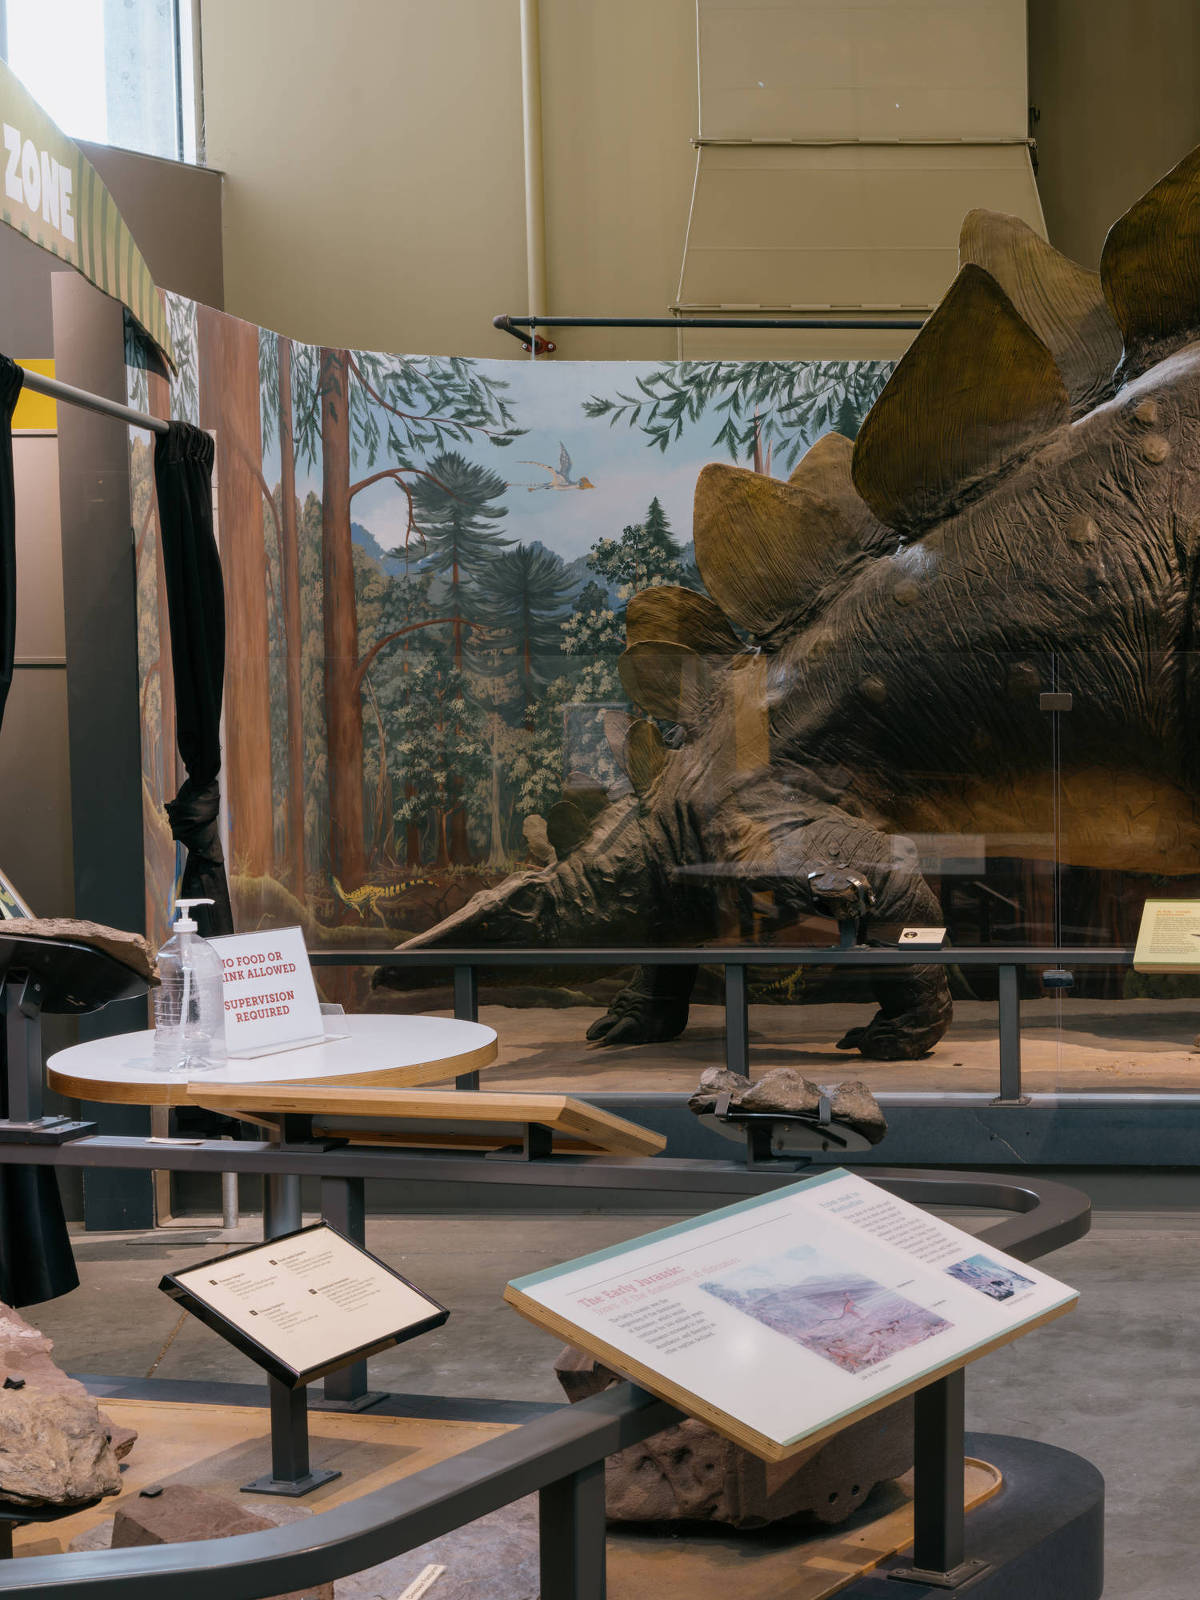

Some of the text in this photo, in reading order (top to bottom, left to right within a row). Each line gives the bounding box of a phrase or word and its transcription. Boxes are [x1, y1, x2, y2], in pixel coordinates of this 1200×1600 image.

[3, 122, 75, 243] ZONE
[236, 954, 265, 967] FOOD
[267, 951, 283, 962] OR
[222, 963, 296, 983] INK ALLOWED
[224, 990, 295, 1010] SUPERVISION
[235, 1005, 290, 1023] REQUIRED
[576, 1296, 604, 1307] The
[600, 1283, 638, 1299] Early
